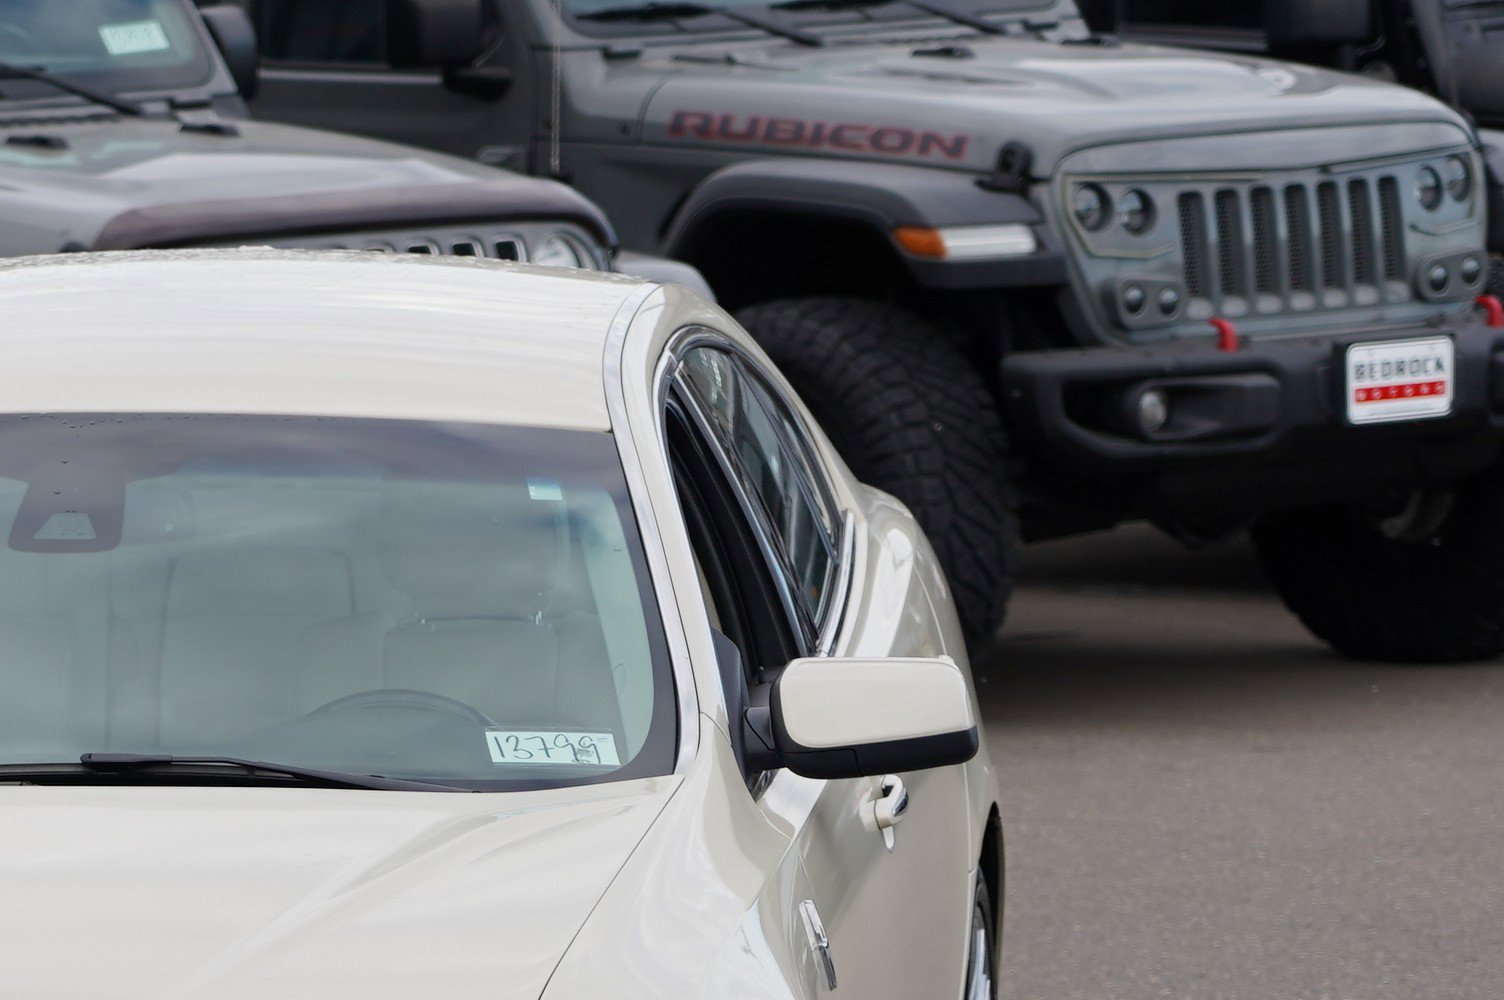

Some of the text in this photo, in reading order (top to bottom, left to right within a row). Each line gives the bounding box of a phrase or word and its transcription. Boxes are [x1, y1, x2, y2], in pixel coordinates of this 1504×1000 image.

[668, 110, 968, 159] RUBICON
[1354, 357, 1444, 380] BEDROCK
[494, 734, 600, 764] 13799
